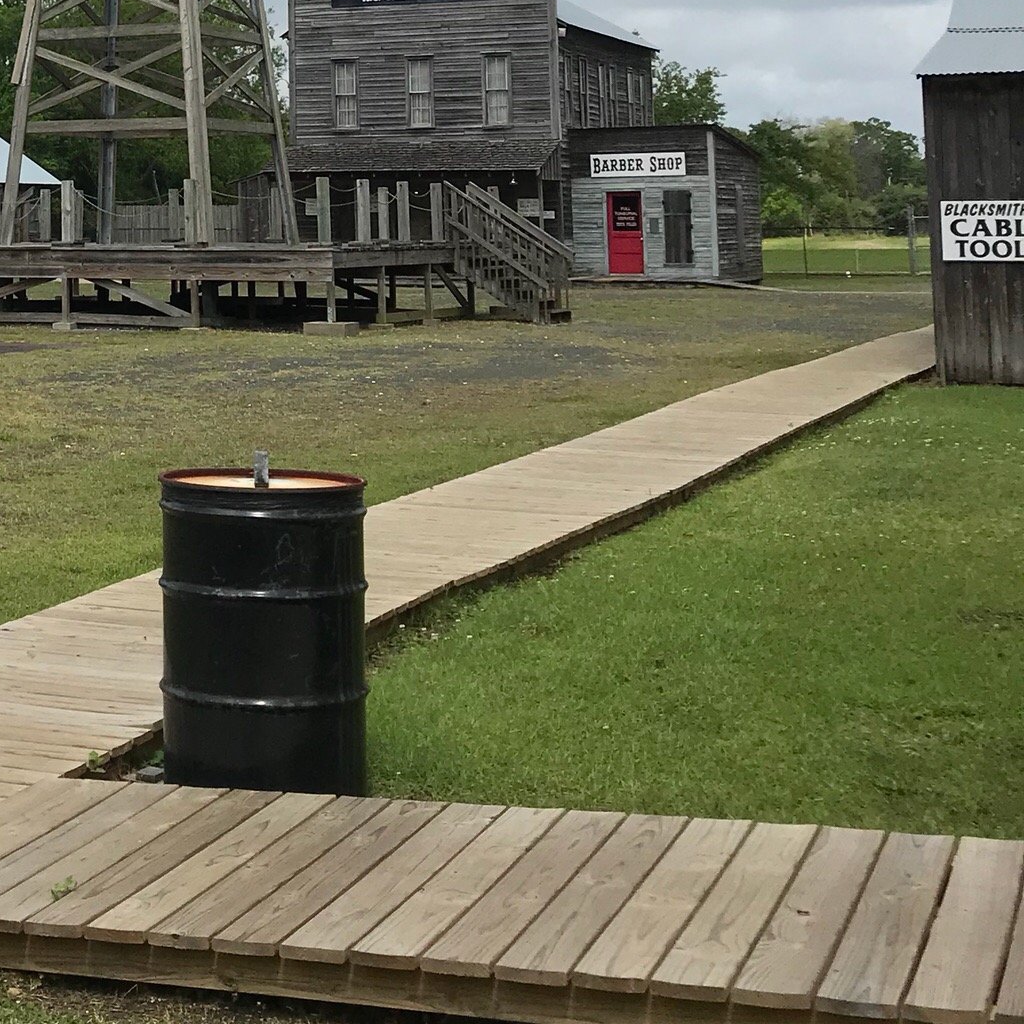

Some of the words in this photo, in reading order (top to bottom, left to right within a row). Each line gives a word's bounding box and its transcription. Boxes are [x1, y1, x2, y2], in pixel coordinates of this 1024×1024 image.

[592, 157, 644, 174] BARBER
[649, 156, 683, 172] SHOP
[950, 219, 1024, 237] CABL
[955, 239, 1024, 258] TOOL
